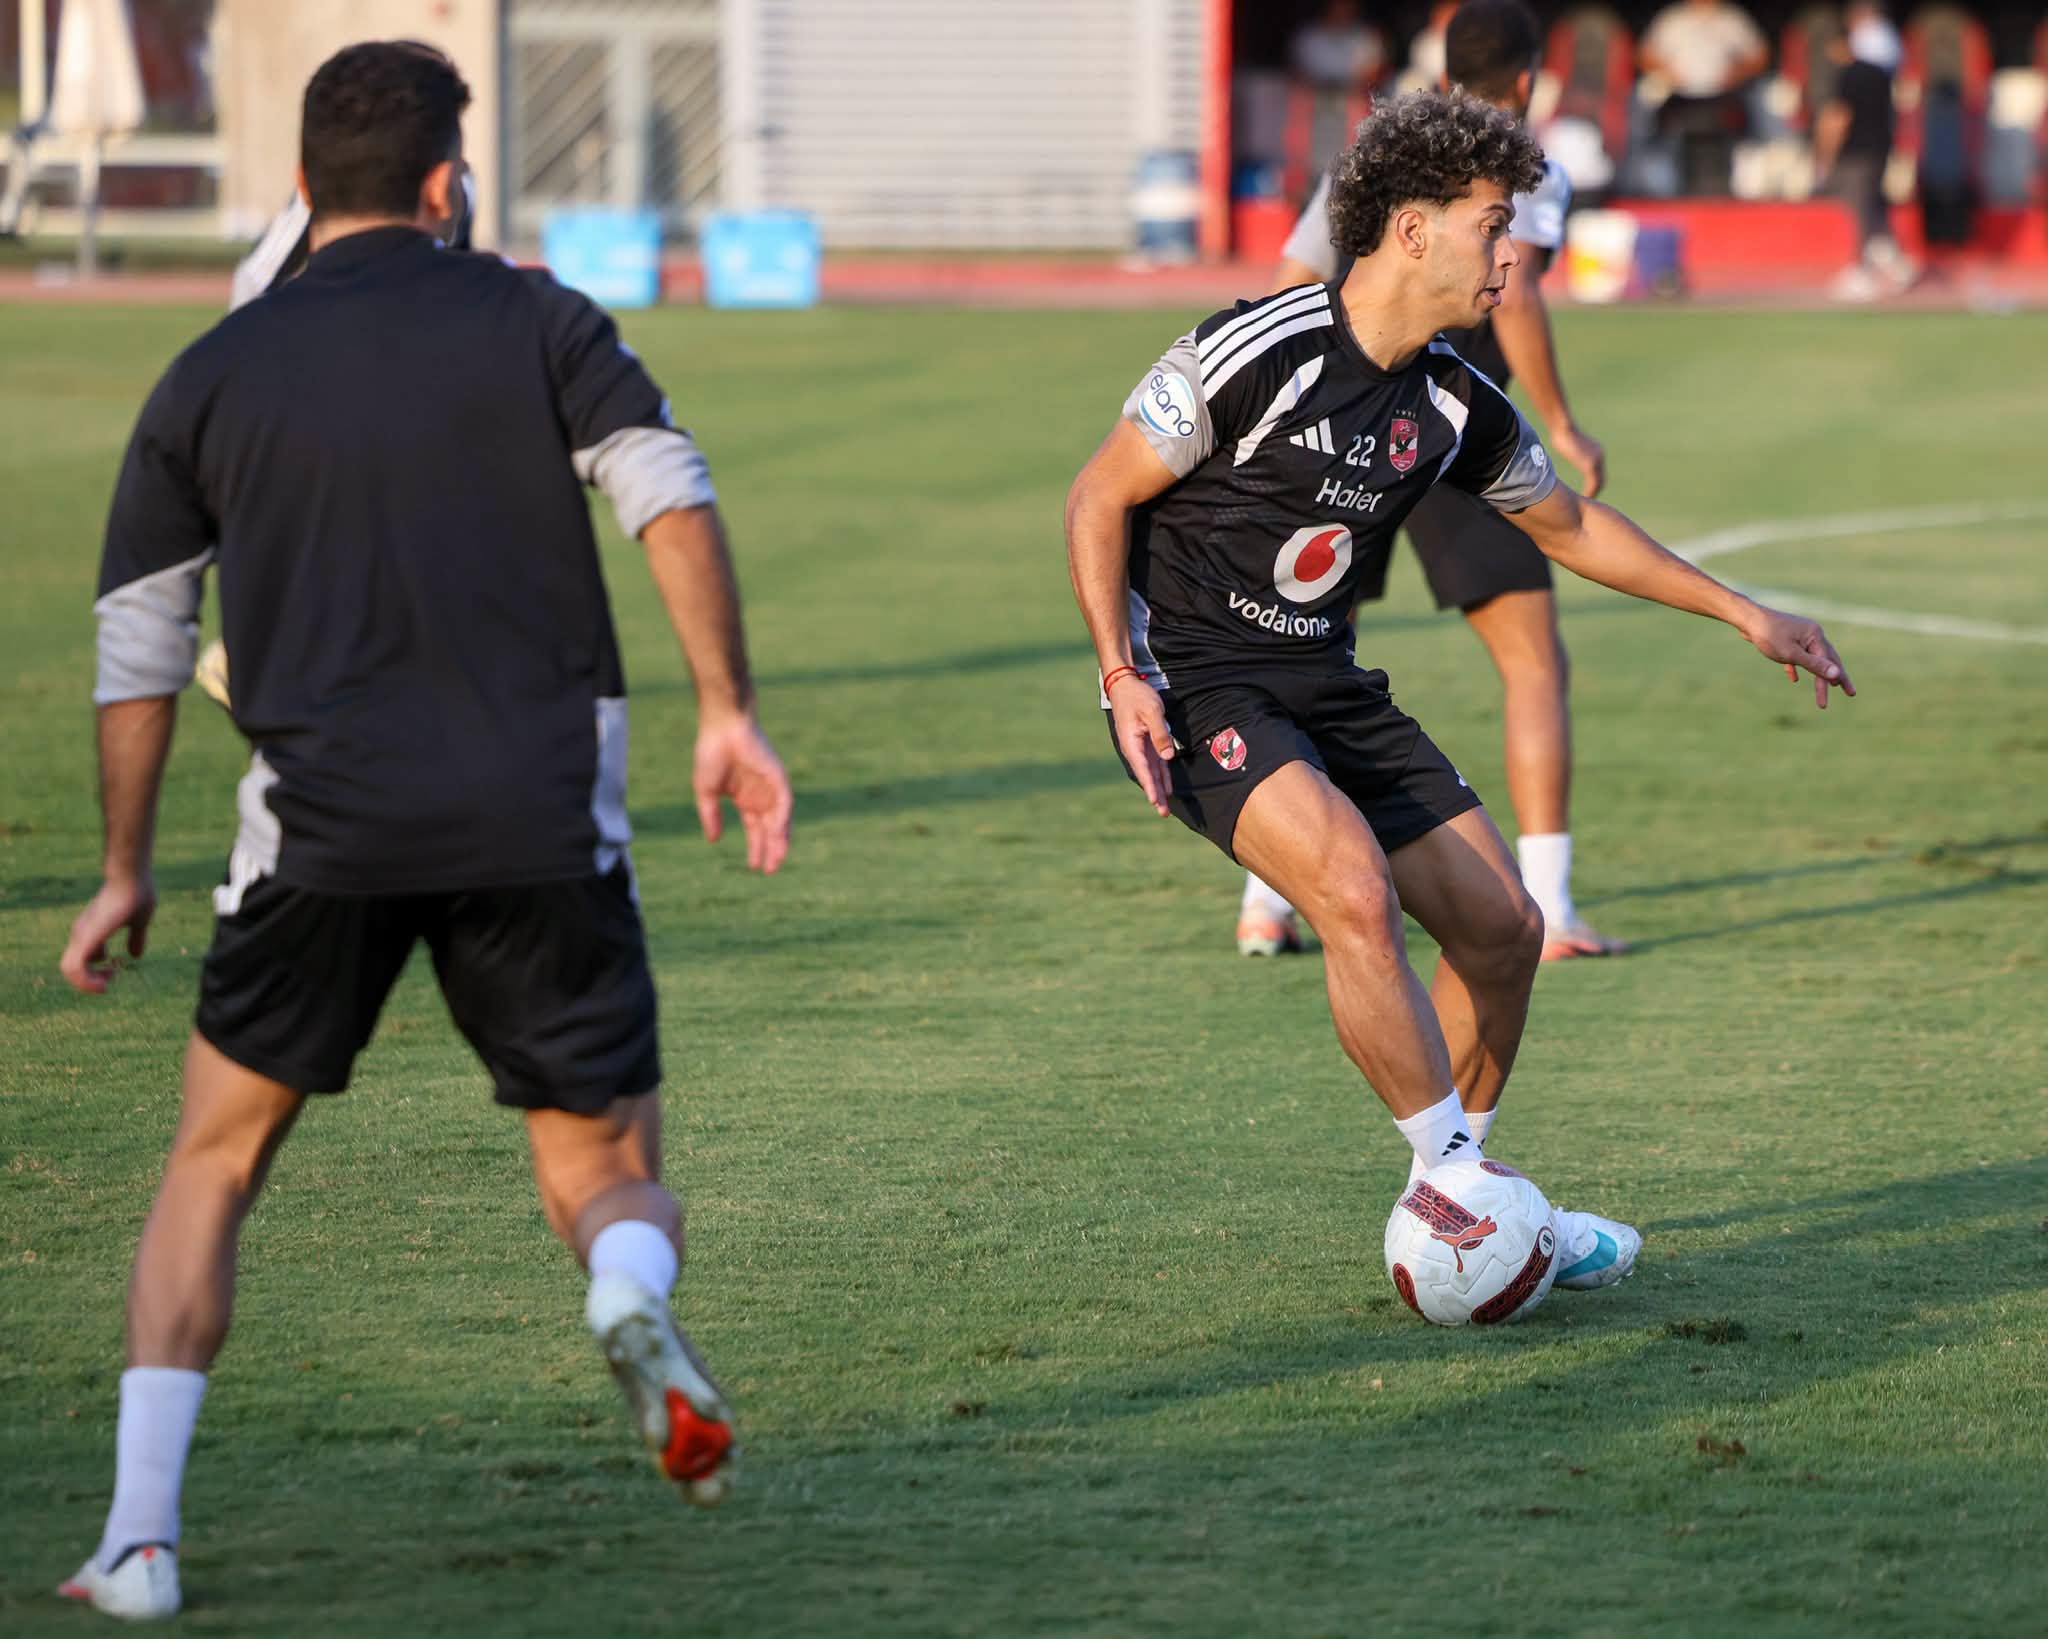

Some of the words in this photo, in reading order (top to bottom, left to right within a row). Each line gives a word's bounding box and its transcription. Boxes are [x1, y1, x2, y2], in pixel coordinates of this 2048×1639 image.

[1150, 374, 1195, 437] elano
[1345, 434, 1376, 468] 22
[1315, 477, 1383, 513] Haier
[1228, 591, 1330, 637] vodafone
